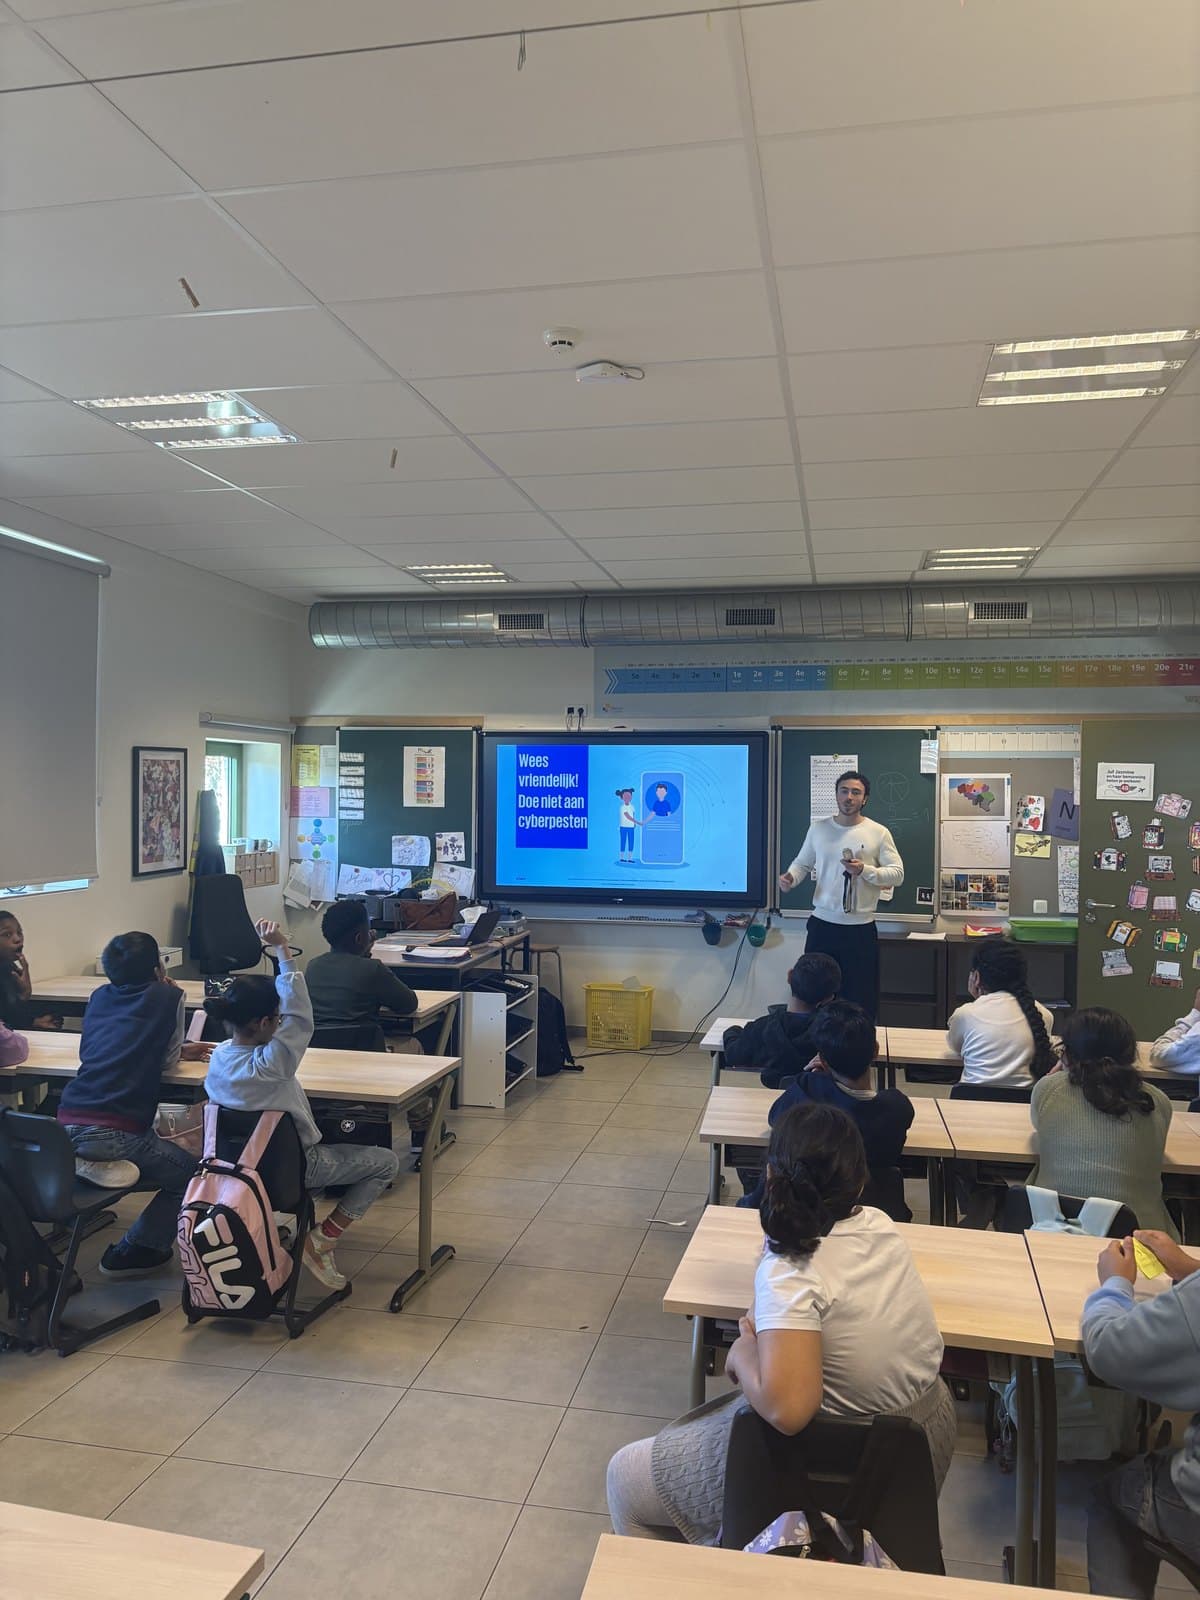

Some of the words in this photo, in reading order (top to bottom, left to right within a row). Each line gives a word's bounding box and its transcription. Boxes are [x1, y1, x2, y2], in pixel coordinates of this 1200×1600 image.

[518, 753, 549, 768] Wees
[518, 773, 579, 789] vriendelijk!
[518, 794, 539, 809] Doe
[541, 794, 562, 809] niet
[564, 796, 584, 809] aan
[518, 814, 588, 830] cyberpesten
[194, 1213, 256, 1310] FILA
